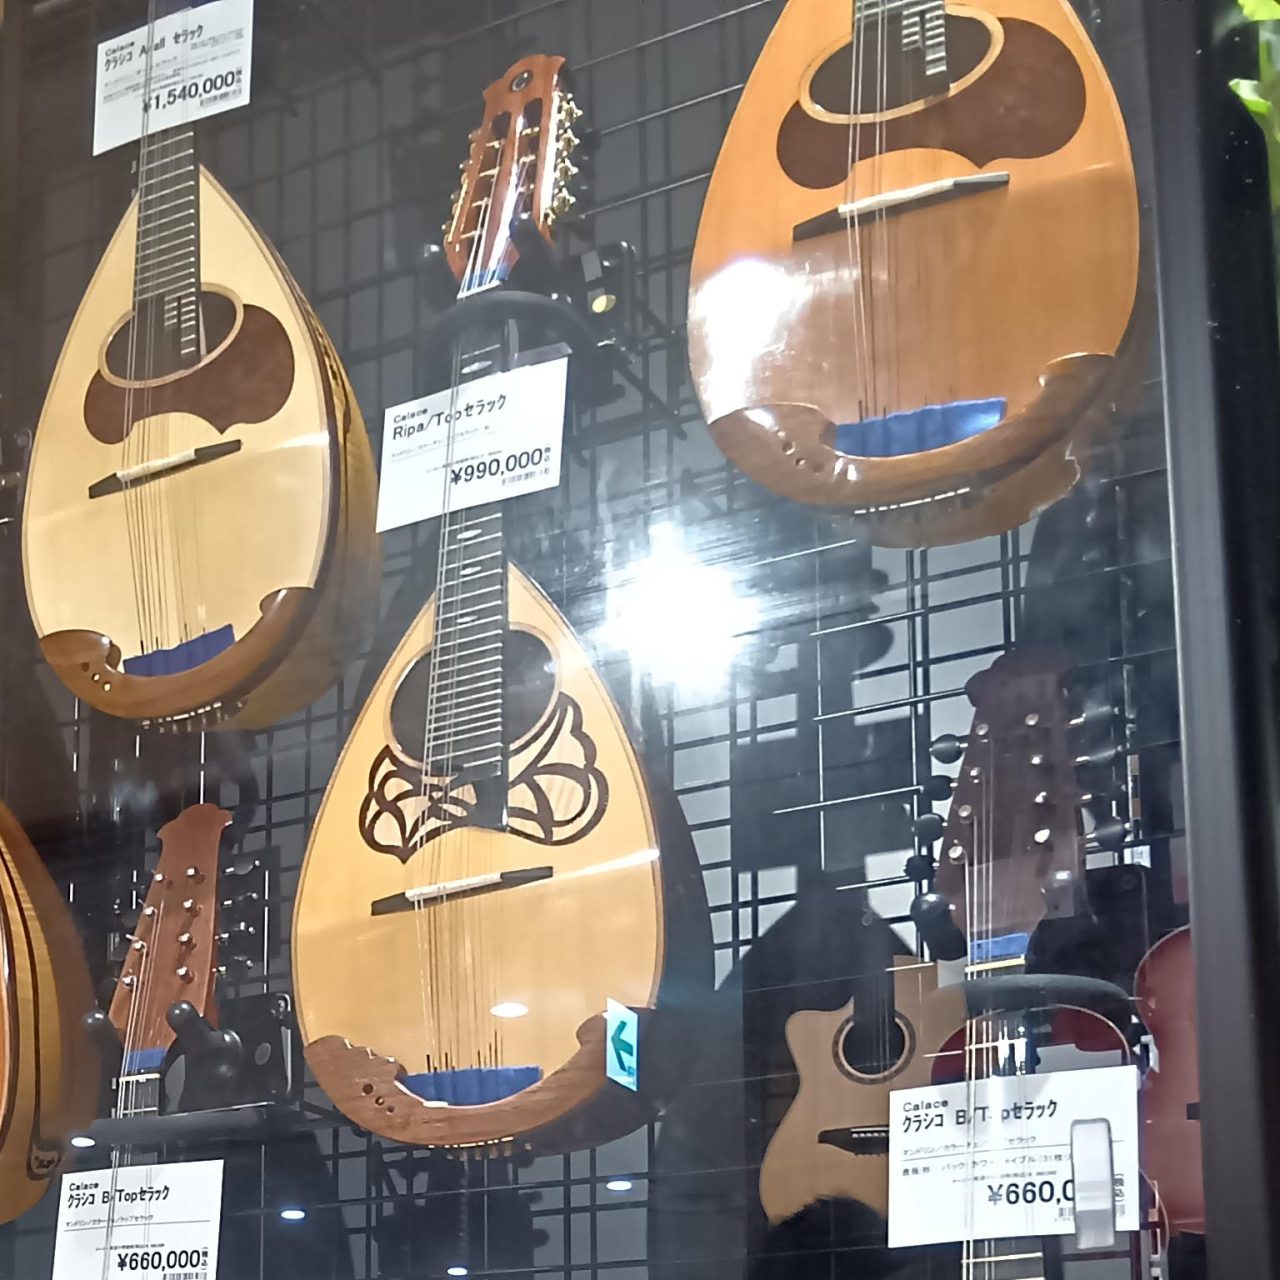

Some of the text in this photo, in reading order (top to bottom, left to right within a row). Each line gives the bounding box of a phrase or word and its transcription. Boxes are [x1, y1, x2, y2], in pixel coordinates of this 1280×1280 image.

[451, 448, 543, 485] ¥990,000
[903, 1099, 949, 1112] Calace
[902, 1112, 944, 1133] クラシコ
[69, 1182, 99, 1191] Calace
[987, 1179, 1074, 1205] ¥660,0
[67, 1193, 95, 1208] クラシコ
[117, 1249, 201, 1272] ¥660,000
